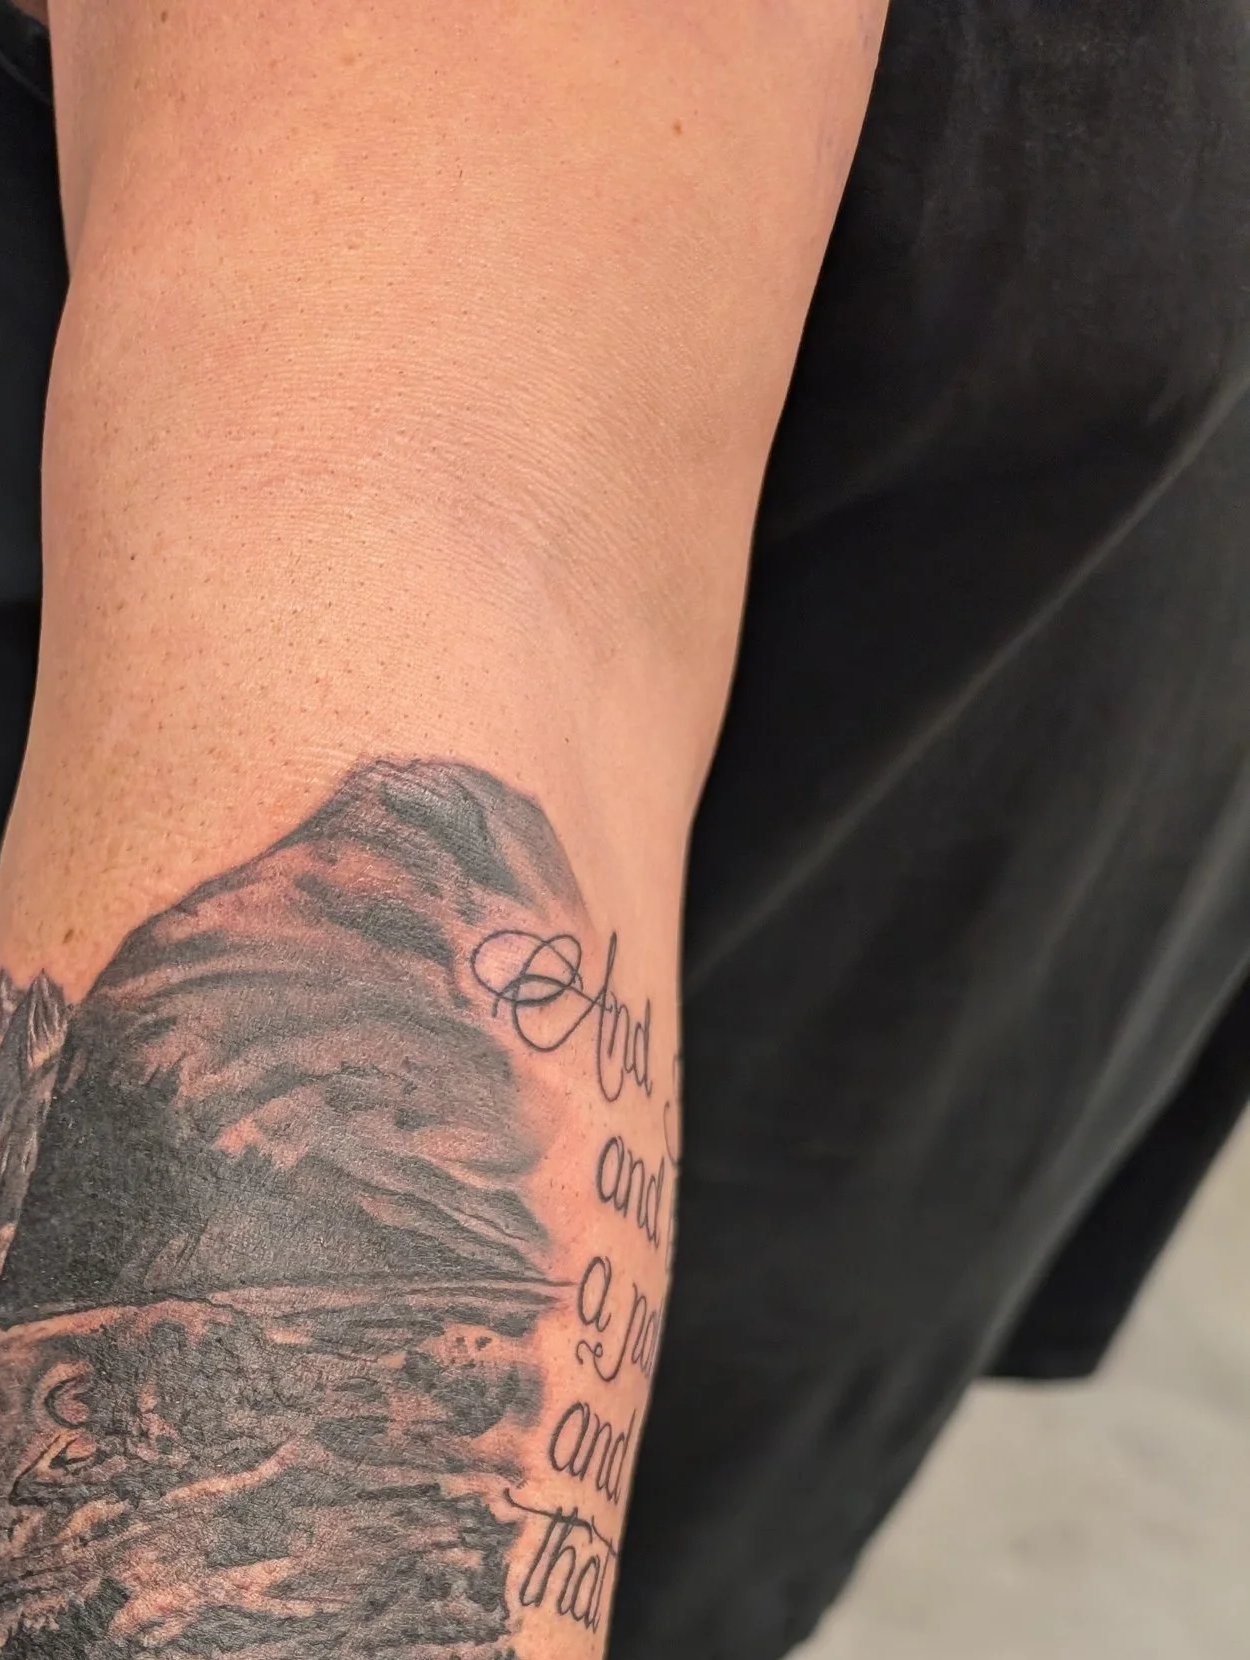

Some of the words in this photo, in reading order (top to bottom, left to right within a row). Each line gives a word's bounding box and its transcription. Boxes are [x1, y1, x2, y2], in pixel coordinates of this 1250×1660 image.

[469, 928, 654, 1103] And
[595, 1134, 665, 1250] and
[577, 1255, 613, 1333] a
[549, 1400, 637, 1506] and
